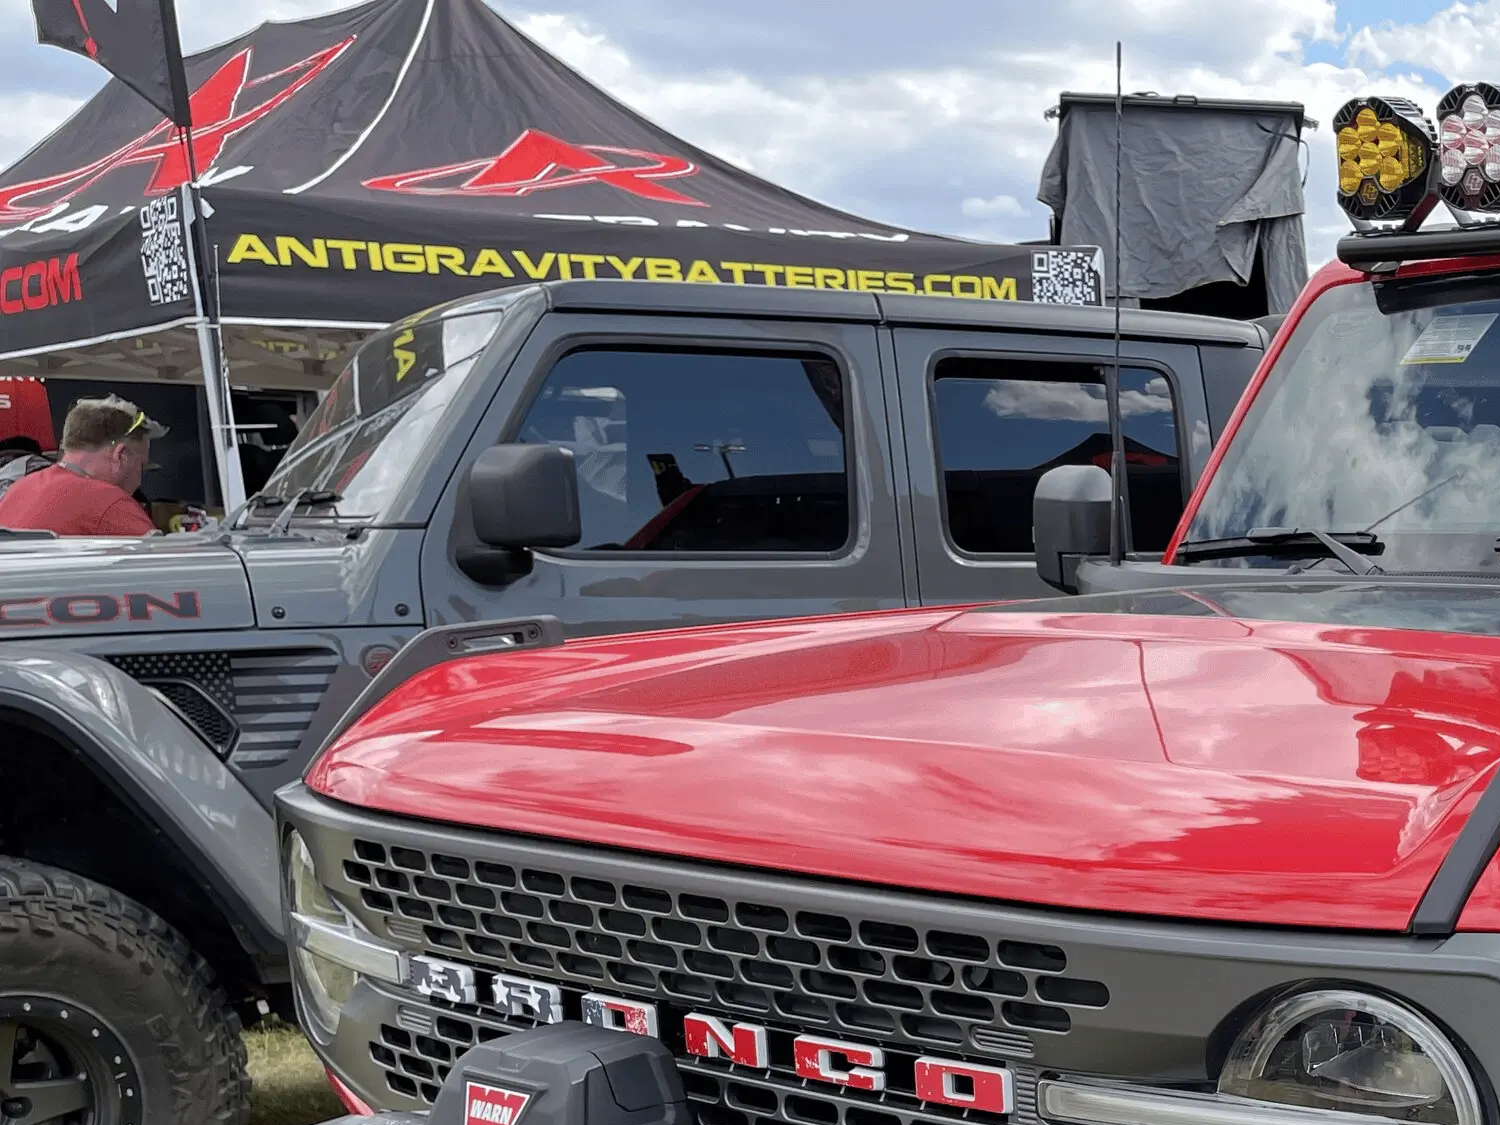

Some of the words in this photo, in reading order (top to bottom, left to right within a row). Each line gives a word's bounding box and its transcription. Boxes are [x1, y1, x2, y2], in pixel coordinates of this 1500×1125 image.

[227, 233, 1018, 301] ANTIGRAVITYBATTERIES.COM
[408, 954, 1014, 1114] BRONCO
[469, 1099, 514, 1125] WARN
